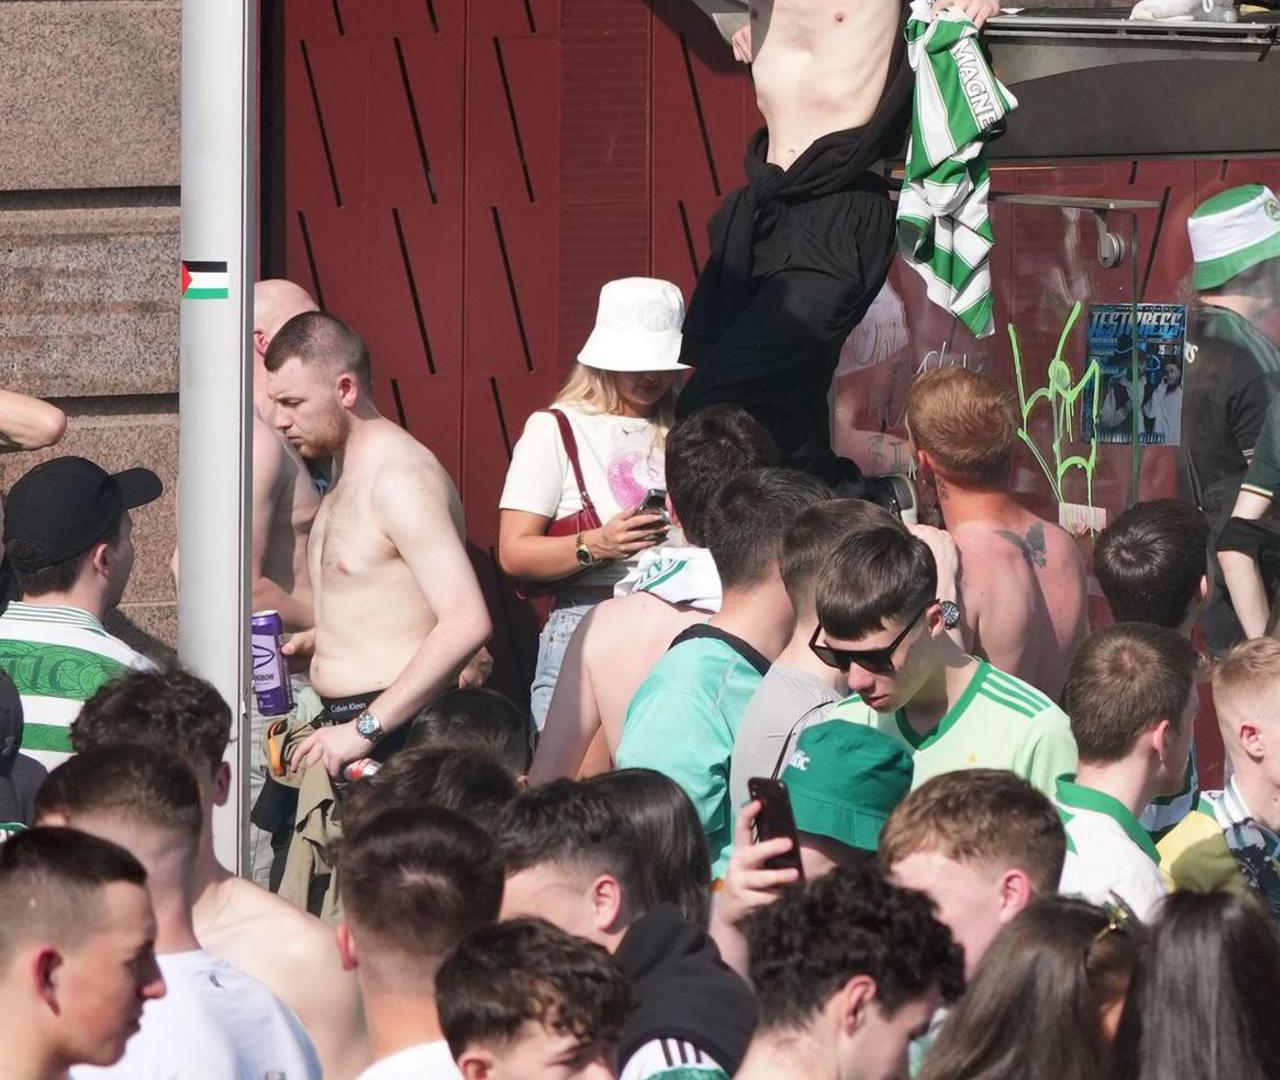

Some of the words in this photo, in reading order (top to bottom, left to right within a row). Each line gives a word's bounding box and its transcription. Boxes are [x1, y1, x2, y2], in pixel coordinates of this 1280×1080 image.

[950, 38, 999, 130] MAGNE
[330, 703, 349, 713] Calvin
[348, 702, 367, 712] Klein
